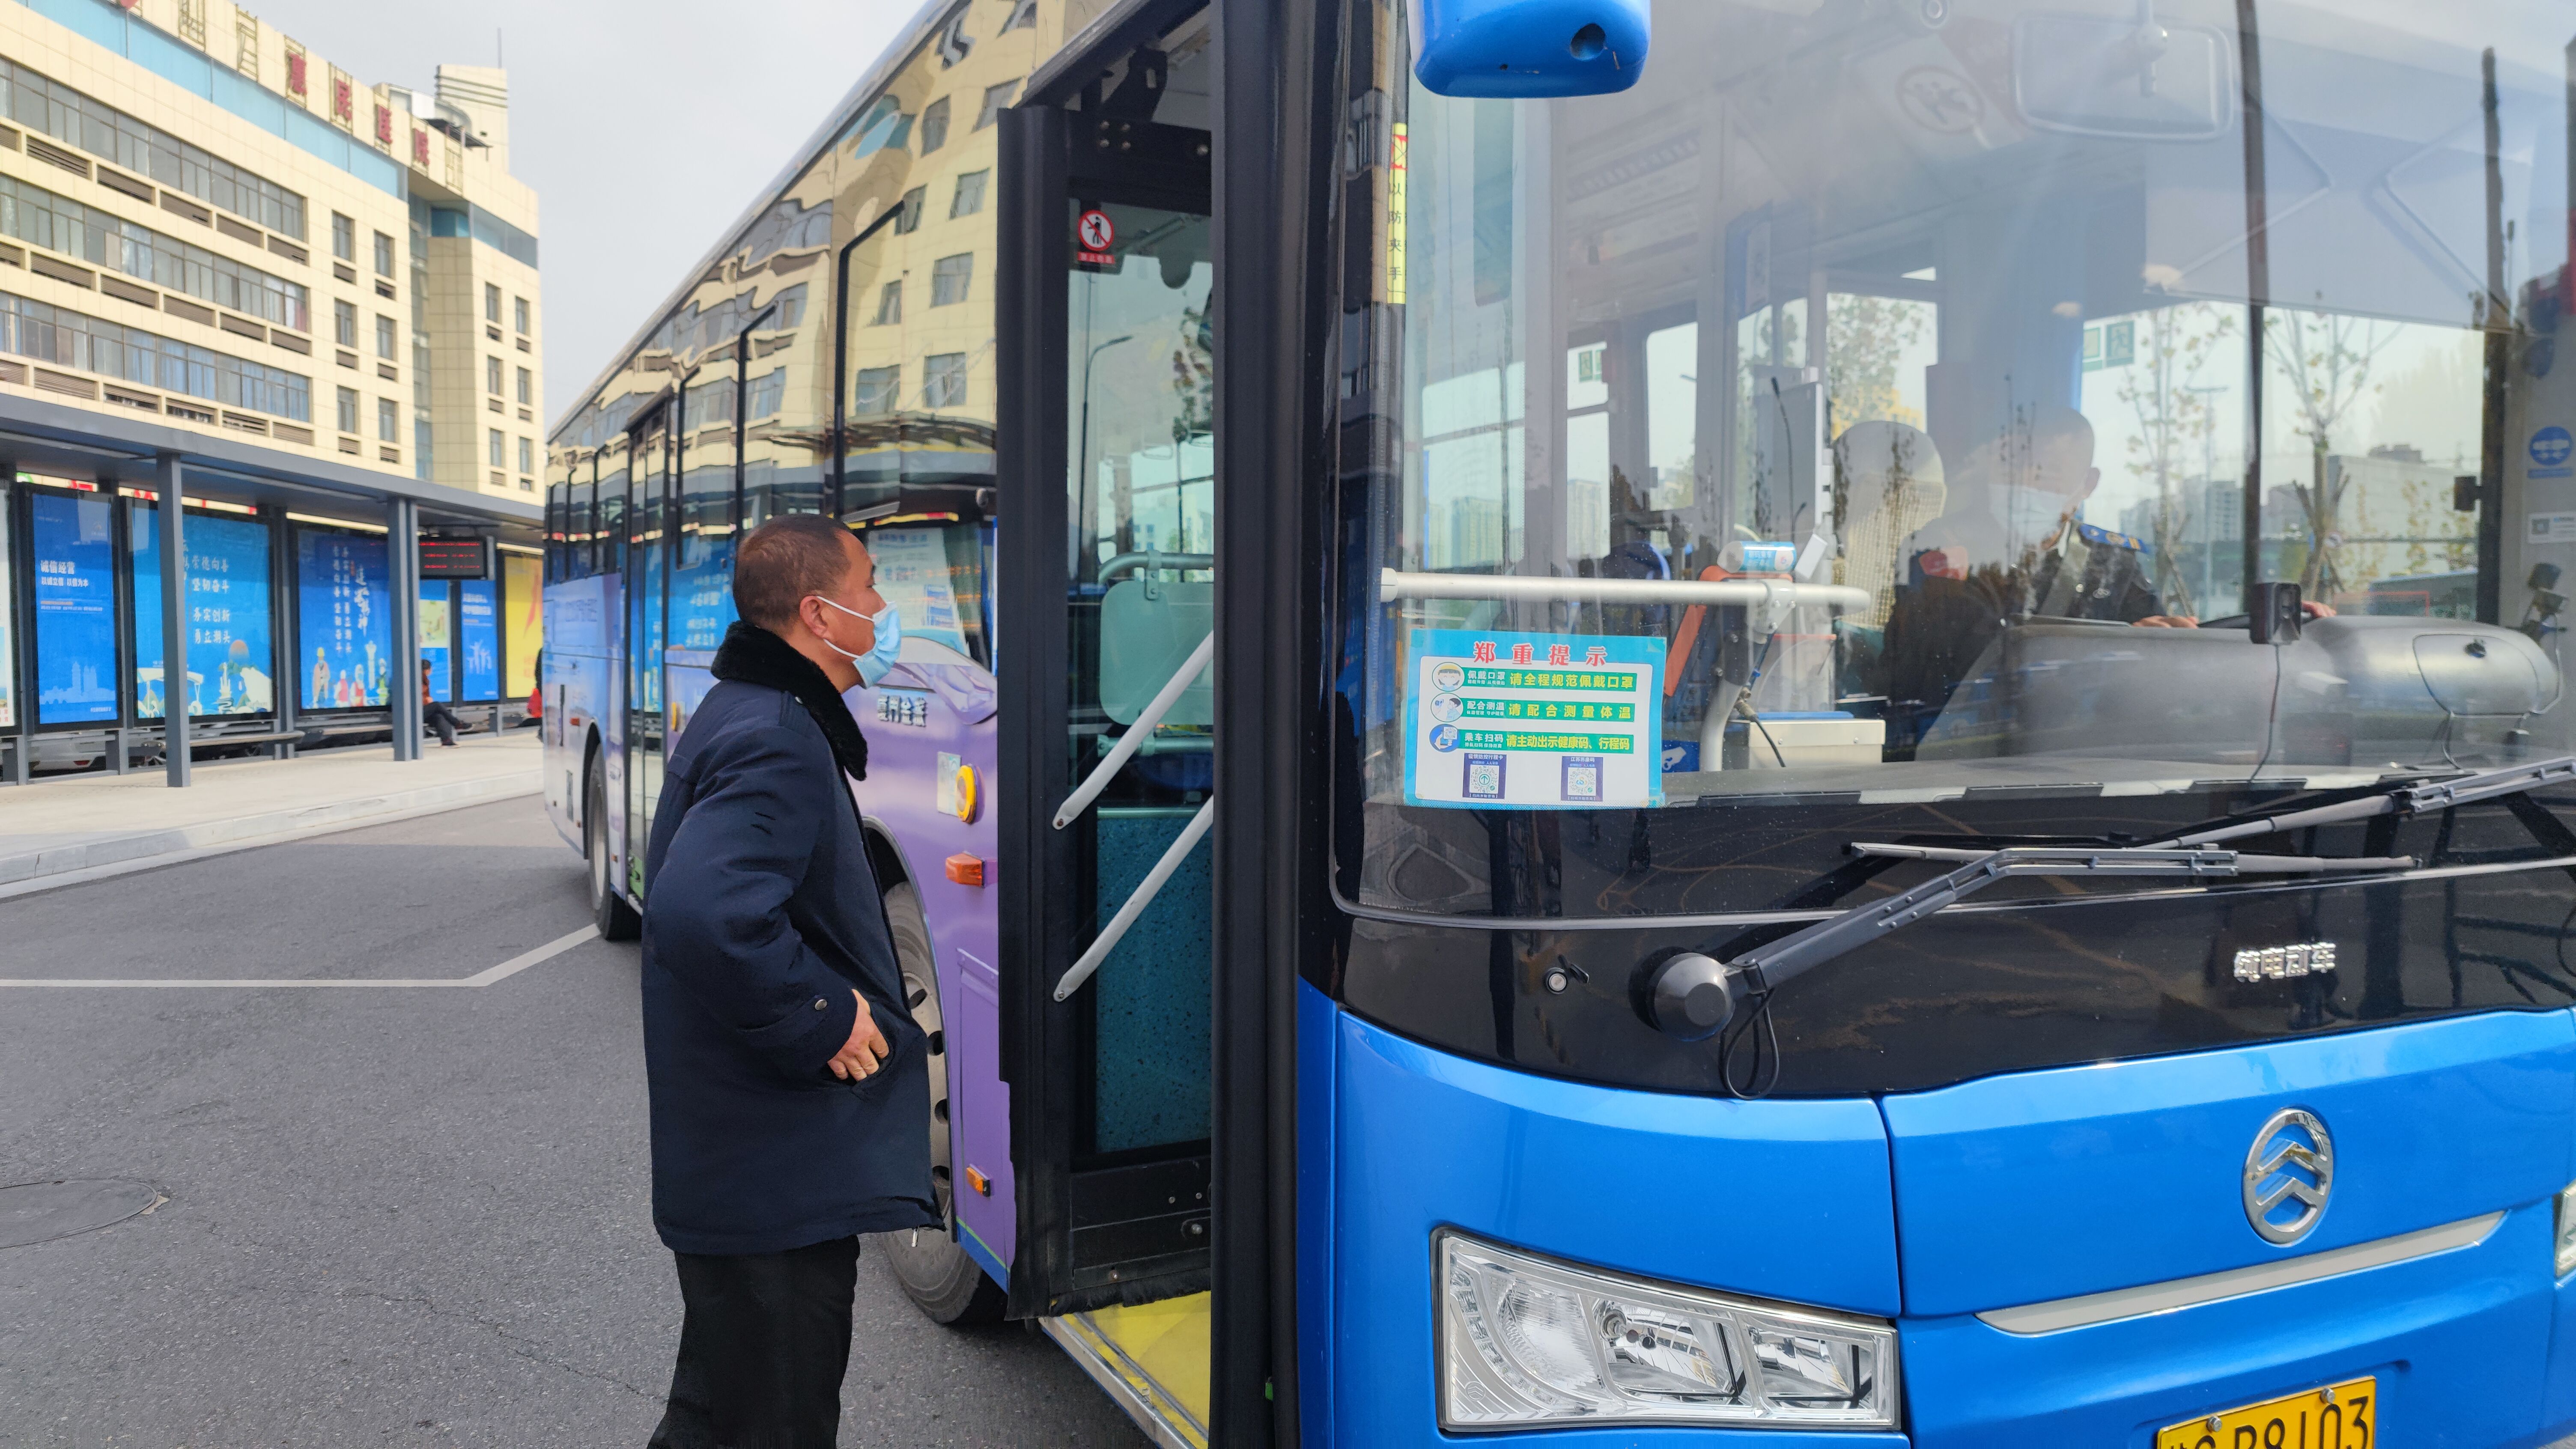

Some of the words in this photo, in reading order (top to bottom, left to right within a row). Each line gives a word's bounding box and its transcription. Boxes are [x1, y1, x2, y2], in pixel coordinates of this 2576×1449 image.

[41, 559, 75, 575] 诚信经营
[195, 628, 230, 644] 勇立潮头
[1473, 641, 1608, 667] 郑重提示
[1467, 670, 1506, 680] 佩戴口罩
[1510, 673, 1634, 689] 请全程规范佩戴口罩
[1467, 701, 1505, 711] 配合测温
[1509, 703, 1631, 719] 请配合测量体温
[1464, 732, 1503, 743] 乘车扫码
[1506, 734, 1630, 750] 请主动出示健康码、行程码
